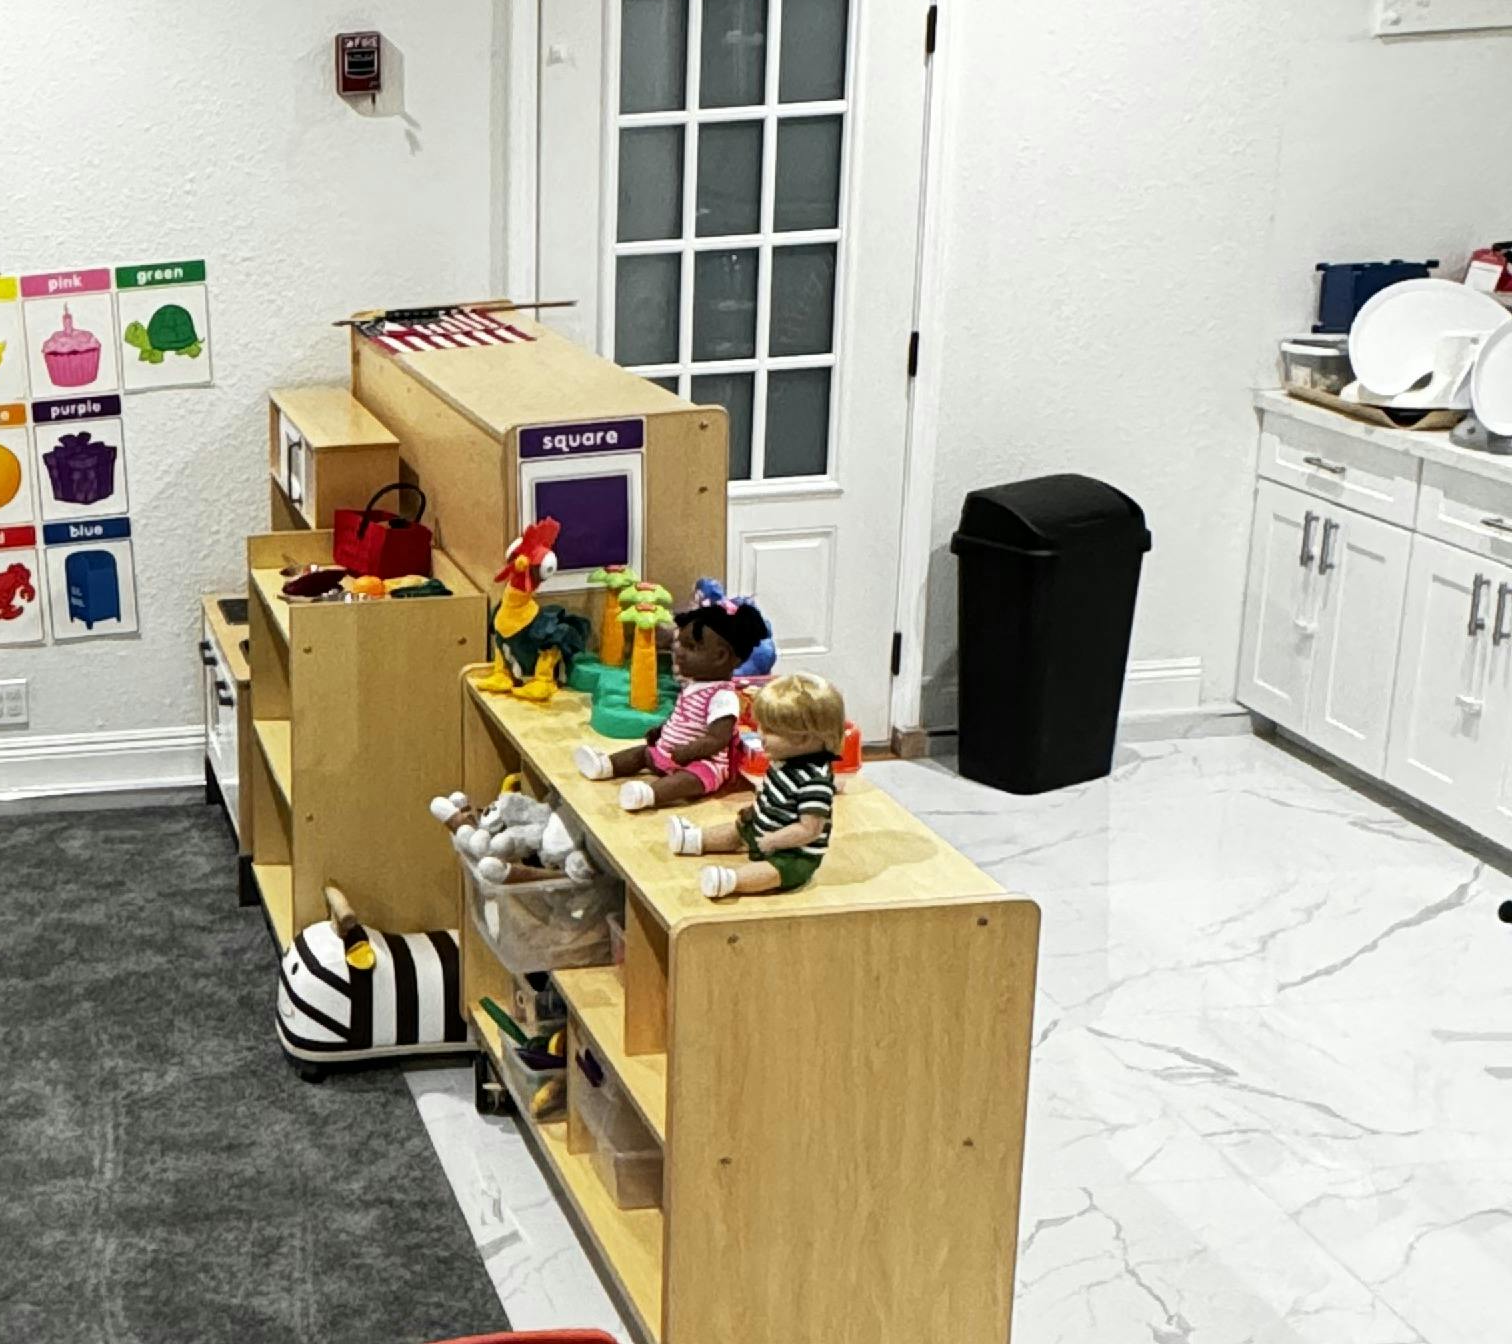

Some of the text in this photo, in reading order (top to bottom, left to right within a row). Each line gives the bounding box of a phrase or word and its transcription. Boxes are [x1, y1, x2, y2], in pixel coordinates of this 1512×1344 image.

[136, 266, 184, 282] green
[48, 275, 82, 292] pink
[50, 401, 102, 419] purple
[542, 430, 618, 452] square
[69, 524, 104, 538] blue
